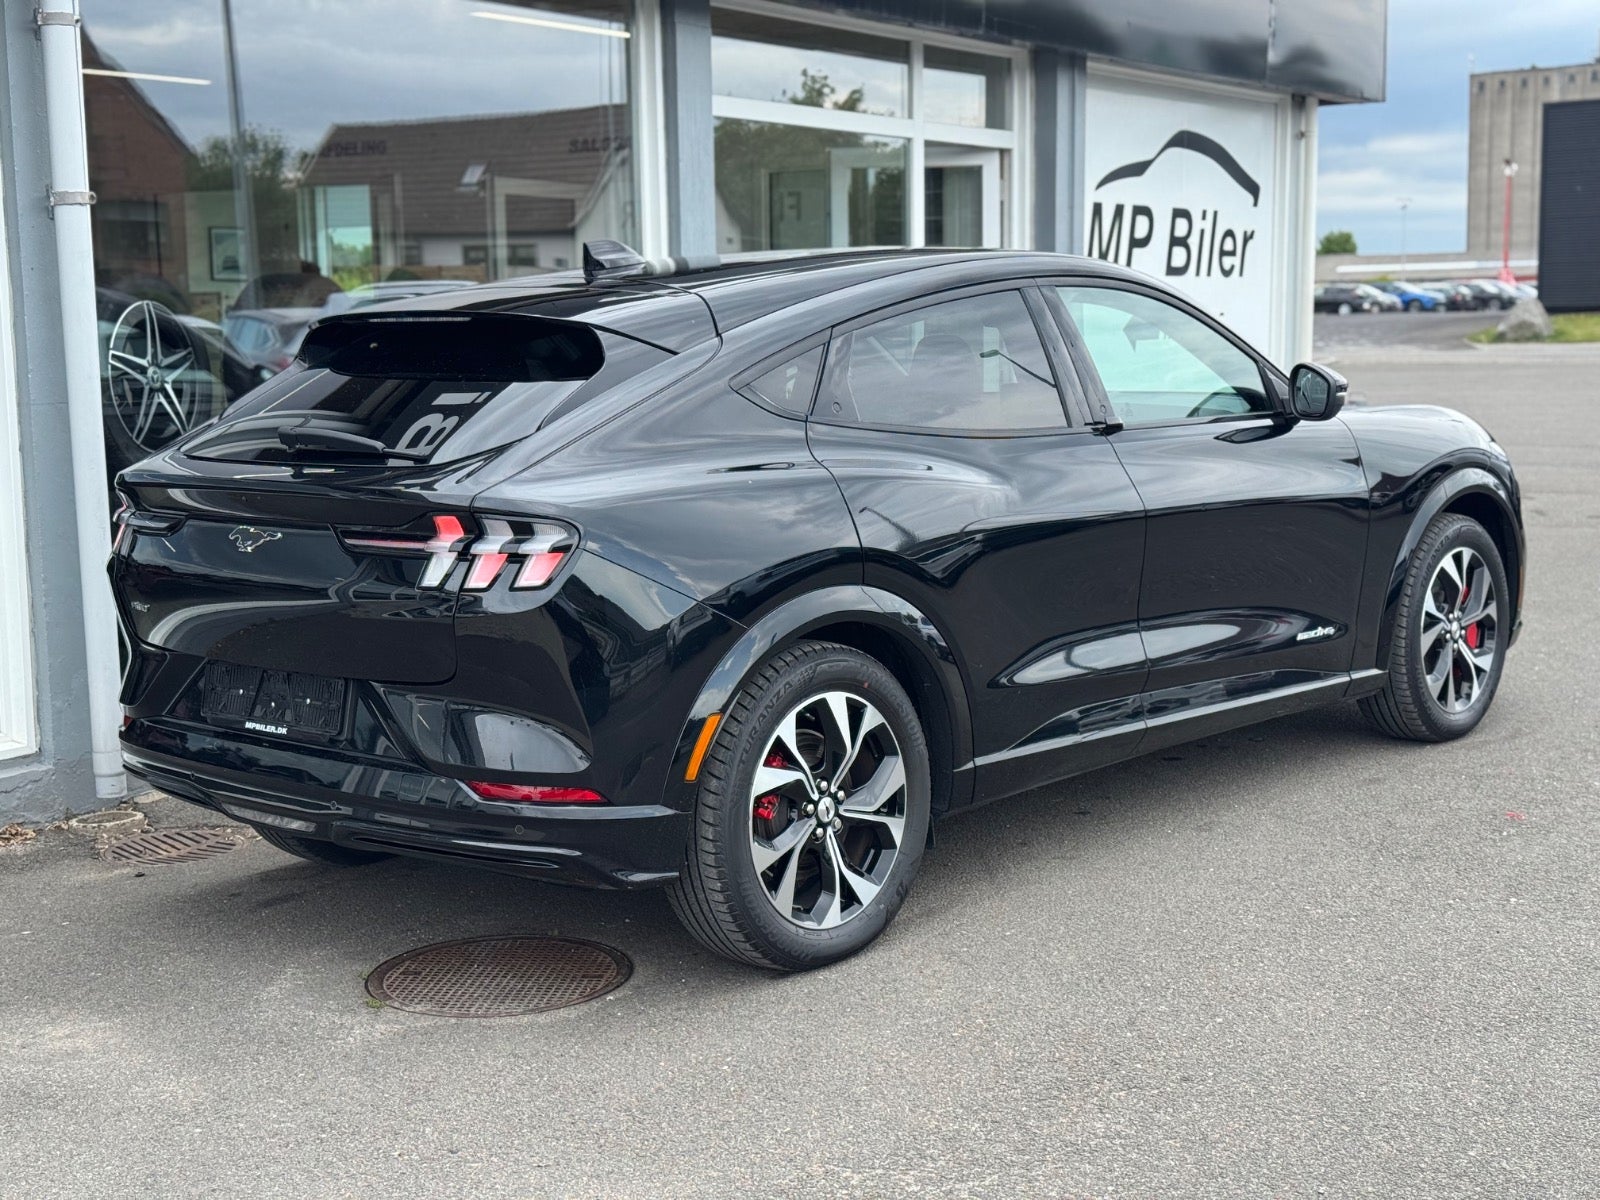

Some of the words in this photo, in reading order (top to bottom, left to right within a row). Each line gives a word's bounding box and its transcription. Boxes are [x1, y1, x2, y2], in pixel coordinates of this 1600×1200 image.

[1087, 202, 1154, 267] MP
[1165, 207, 1255, 278] Biler
[244, 721, 288, 735] MPBILER.DK
[739, 681, 794, 768] TURANZA
